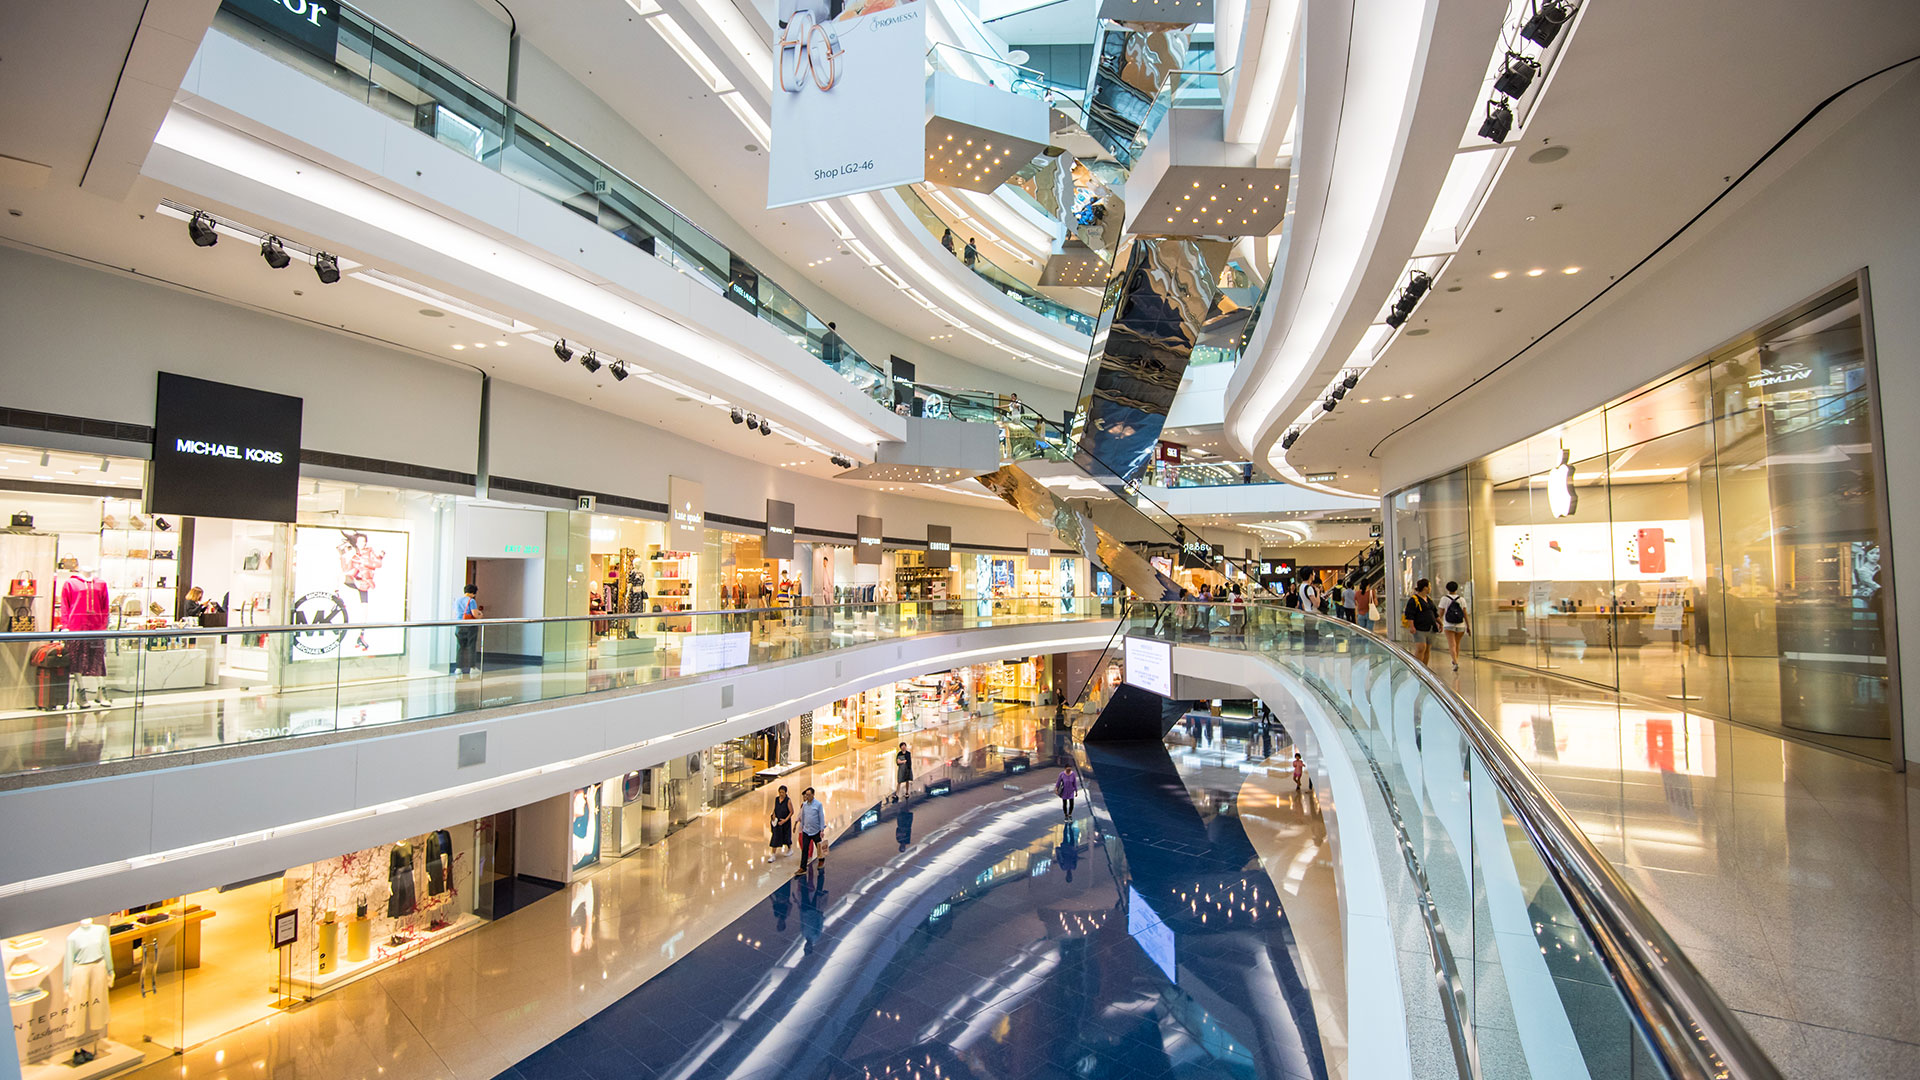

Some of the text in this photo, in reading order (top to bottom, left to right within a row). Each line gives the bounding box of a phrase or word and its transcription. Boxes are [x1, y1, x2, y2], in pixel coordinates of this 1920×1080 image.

[875, 11, 919, 29] PROMESSA
[814, 160, 874, 181] Shop LG2-46
[176, 438, 283, 464] MICHAEL KORS
[674, 509, 702, 524] kate spade
[504, 544, 522, 553] EXIT
[1030, 548, 1049, 557] FURLA
